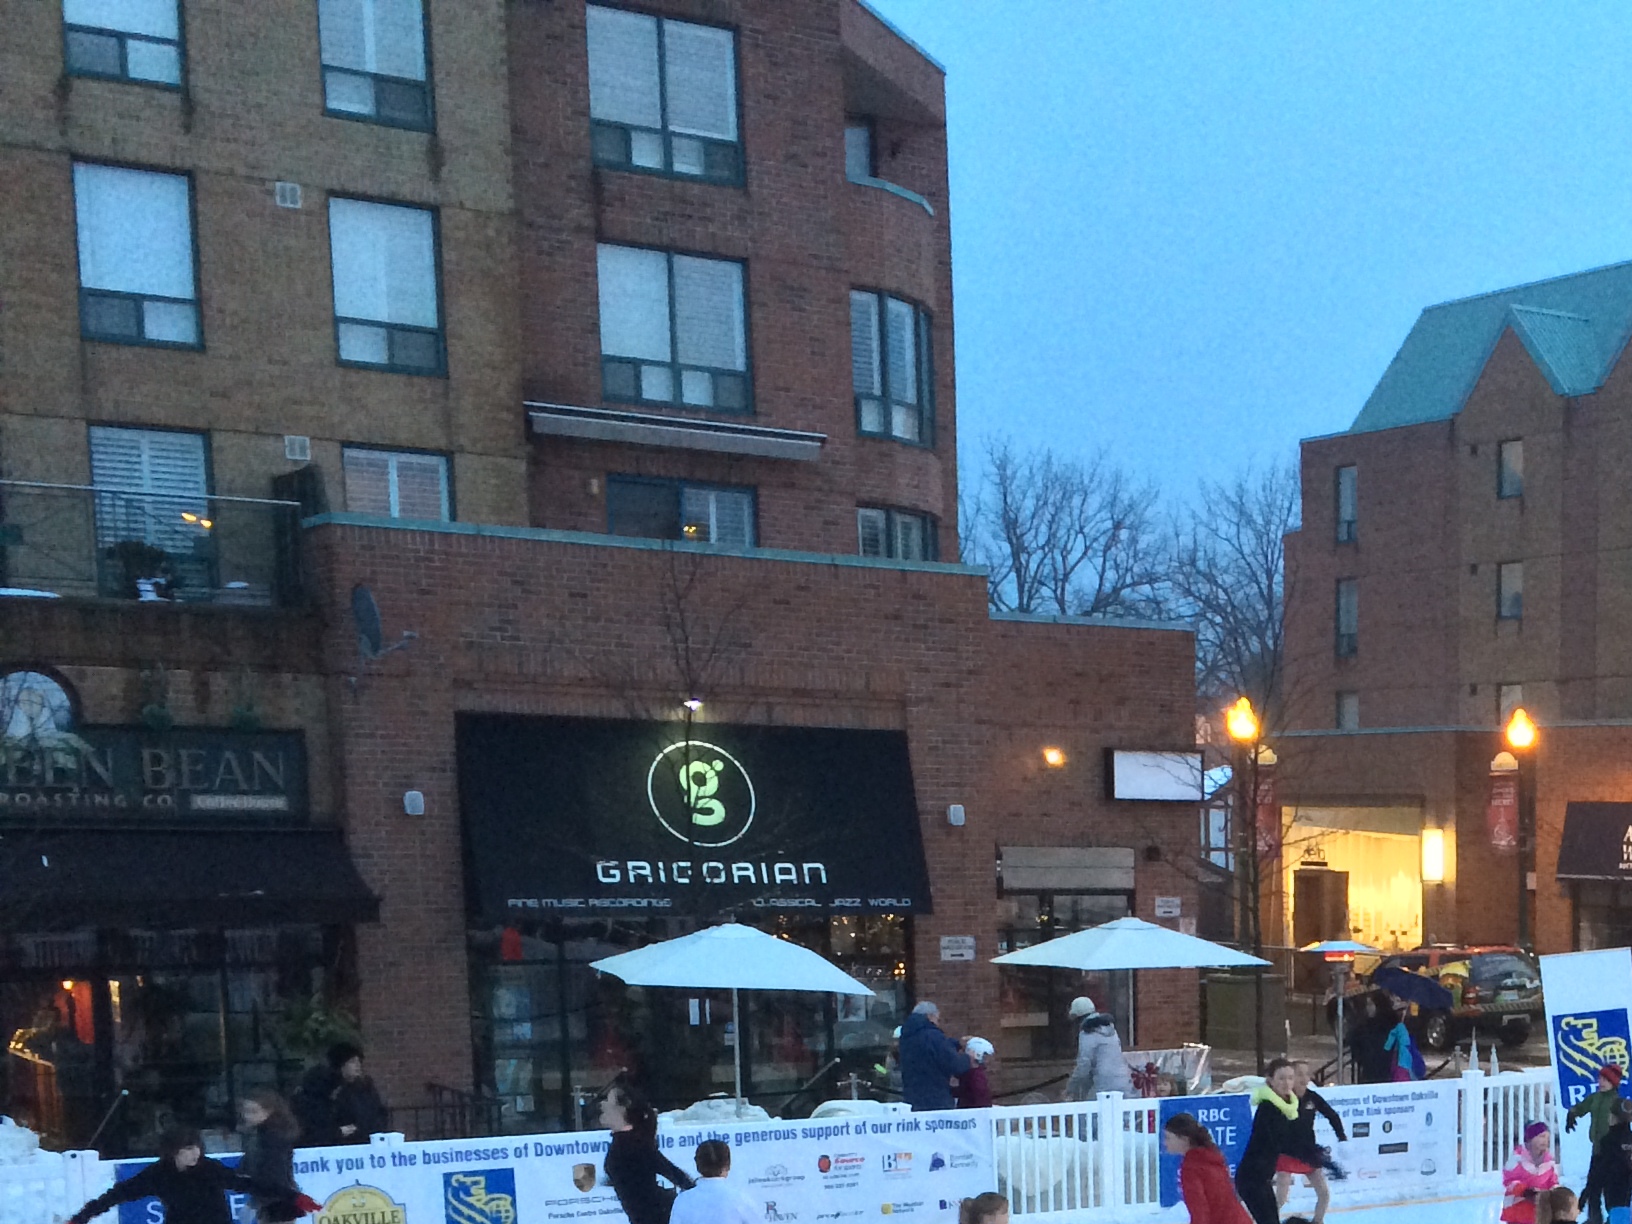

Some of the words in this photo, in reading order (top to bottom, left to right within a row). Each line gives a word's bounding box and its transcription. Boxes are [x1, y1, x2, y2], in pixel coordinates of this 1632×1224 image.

[142, 747, 286, 791] BEAN
[541, 898, 586, 908] MUSIC
[828, 898, 862, 907] JAZZ
[867, 898, 912, 907] WORLD
[1198, 1107, 1231, 1123] RBC
[679, 1131, 702, 1147] and
[735, 1127, 798, 1147] generous
[802, 1124, 850, 1141] support
[854, 1121, 867, 1134] of
[872, 1121, 891, 1135] our
[896, 1119, 921, 1133] rink
[925, 1117, 977, 1133] sponsors
[336, 1156, 364, 1175] you
[370, 1154, 386, 1168] to
[391, 1150, 417, 1167] the
[422, 1144, 509, 1165] businesses
[514, 1142, 530, 1158] of
[534, 1139, 611, 1158] Downtown
[545, 1196, 621, 1206] PORSCHE
